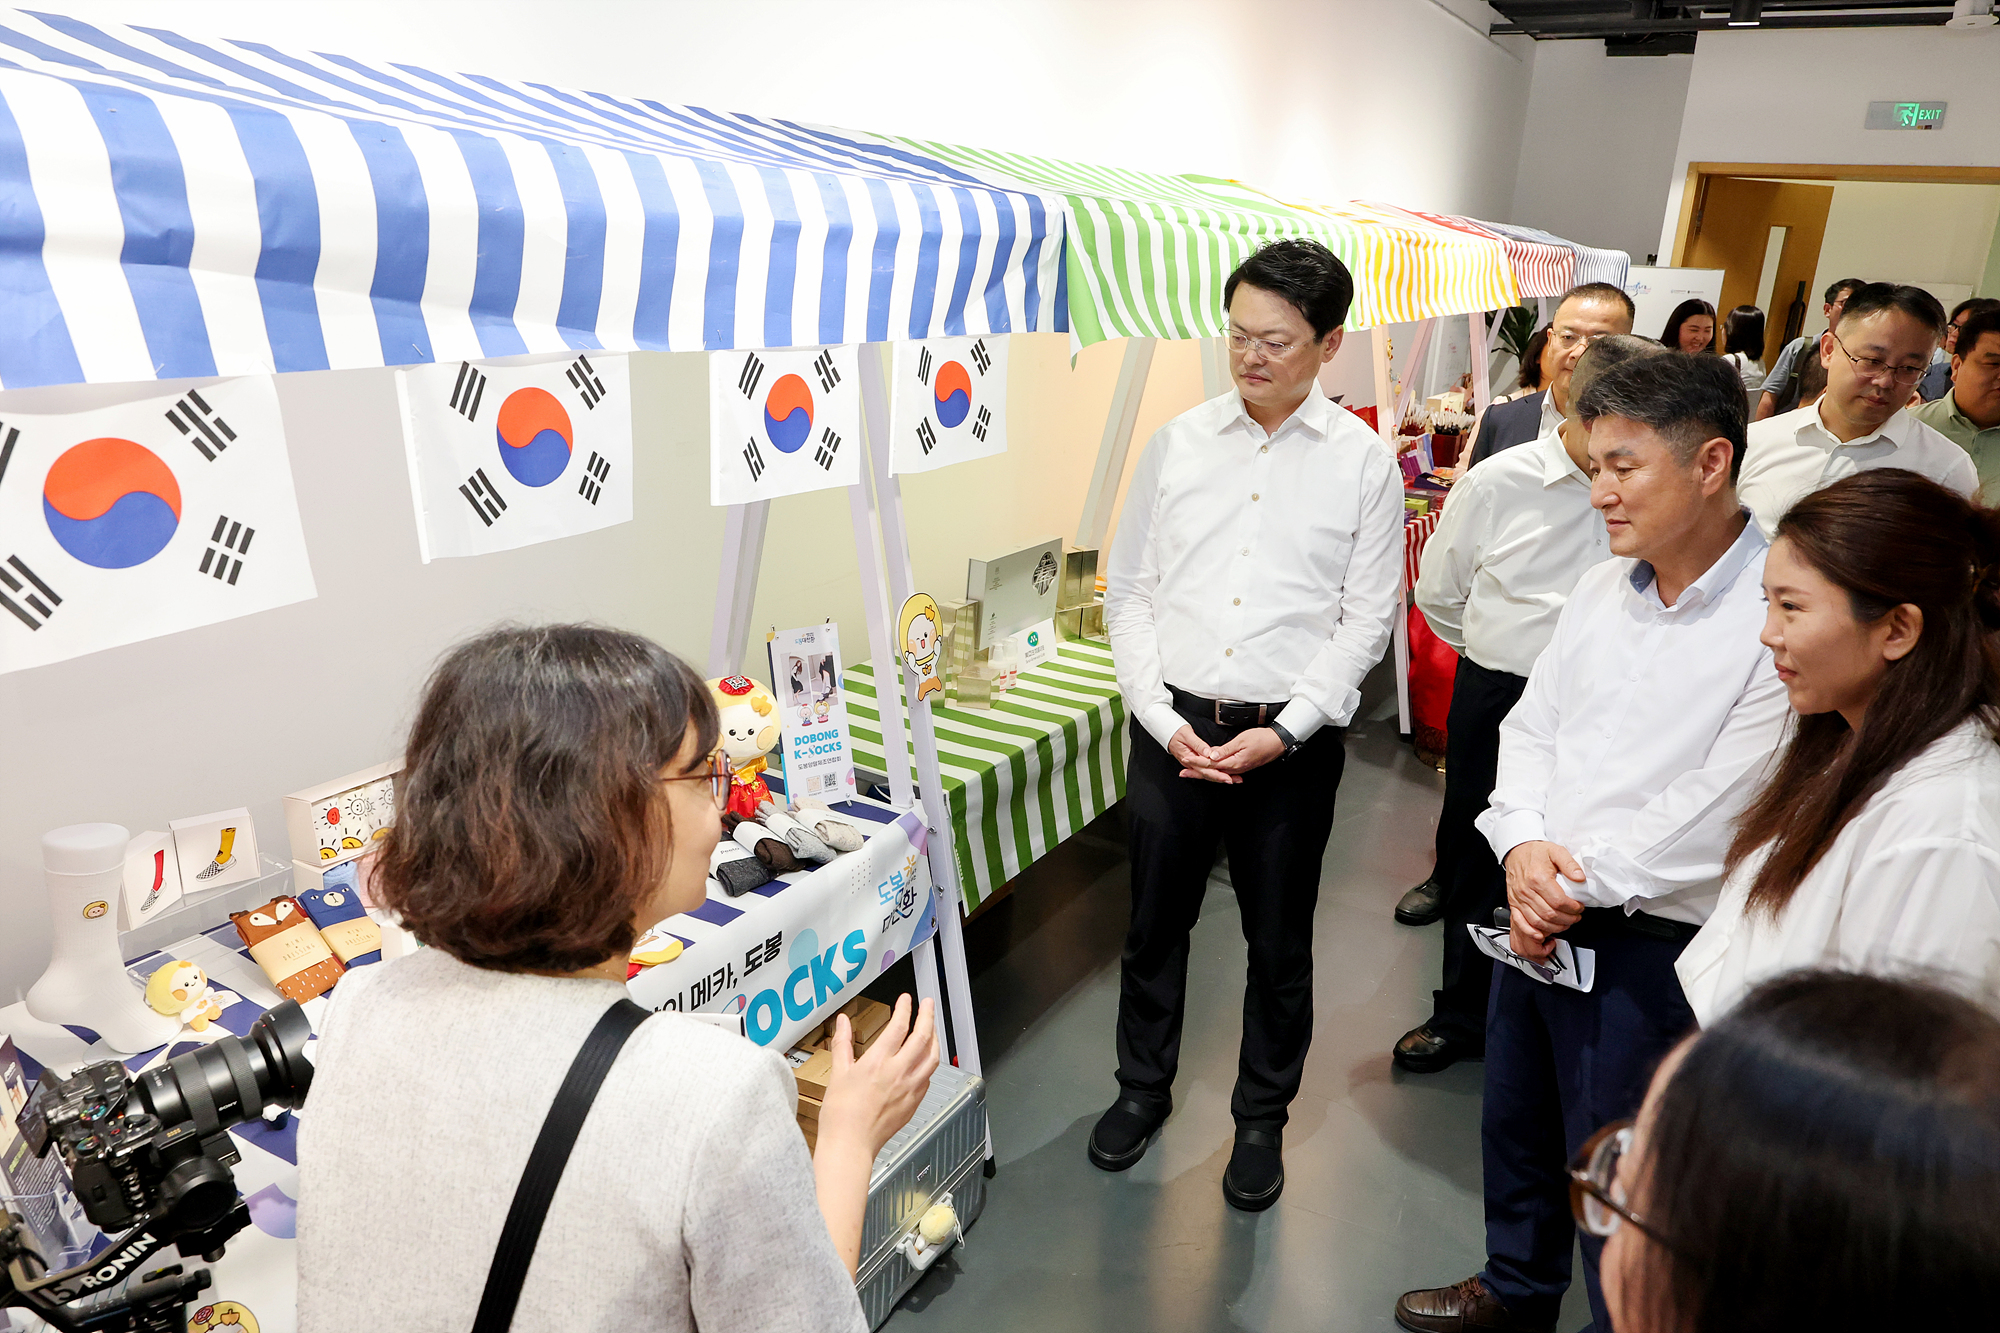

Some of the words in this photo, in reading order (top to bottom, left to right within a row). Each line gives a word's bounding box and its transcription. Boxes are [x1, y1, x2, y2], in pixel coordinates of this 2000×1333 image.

[1918, 109, 1942, 120] EXIT
[794, 729, 839, 746] DOBONG
[794, 741, 842, 759] K-SOCKS
[282, 943, 315, 960] DRESSING
[690, 962, 738, 1012] 메카,
[743, 930, 783, 977] 도봉
[218, 1100, 238, 1111] SONY
[81, 1232, 158, 1288] RONIN
